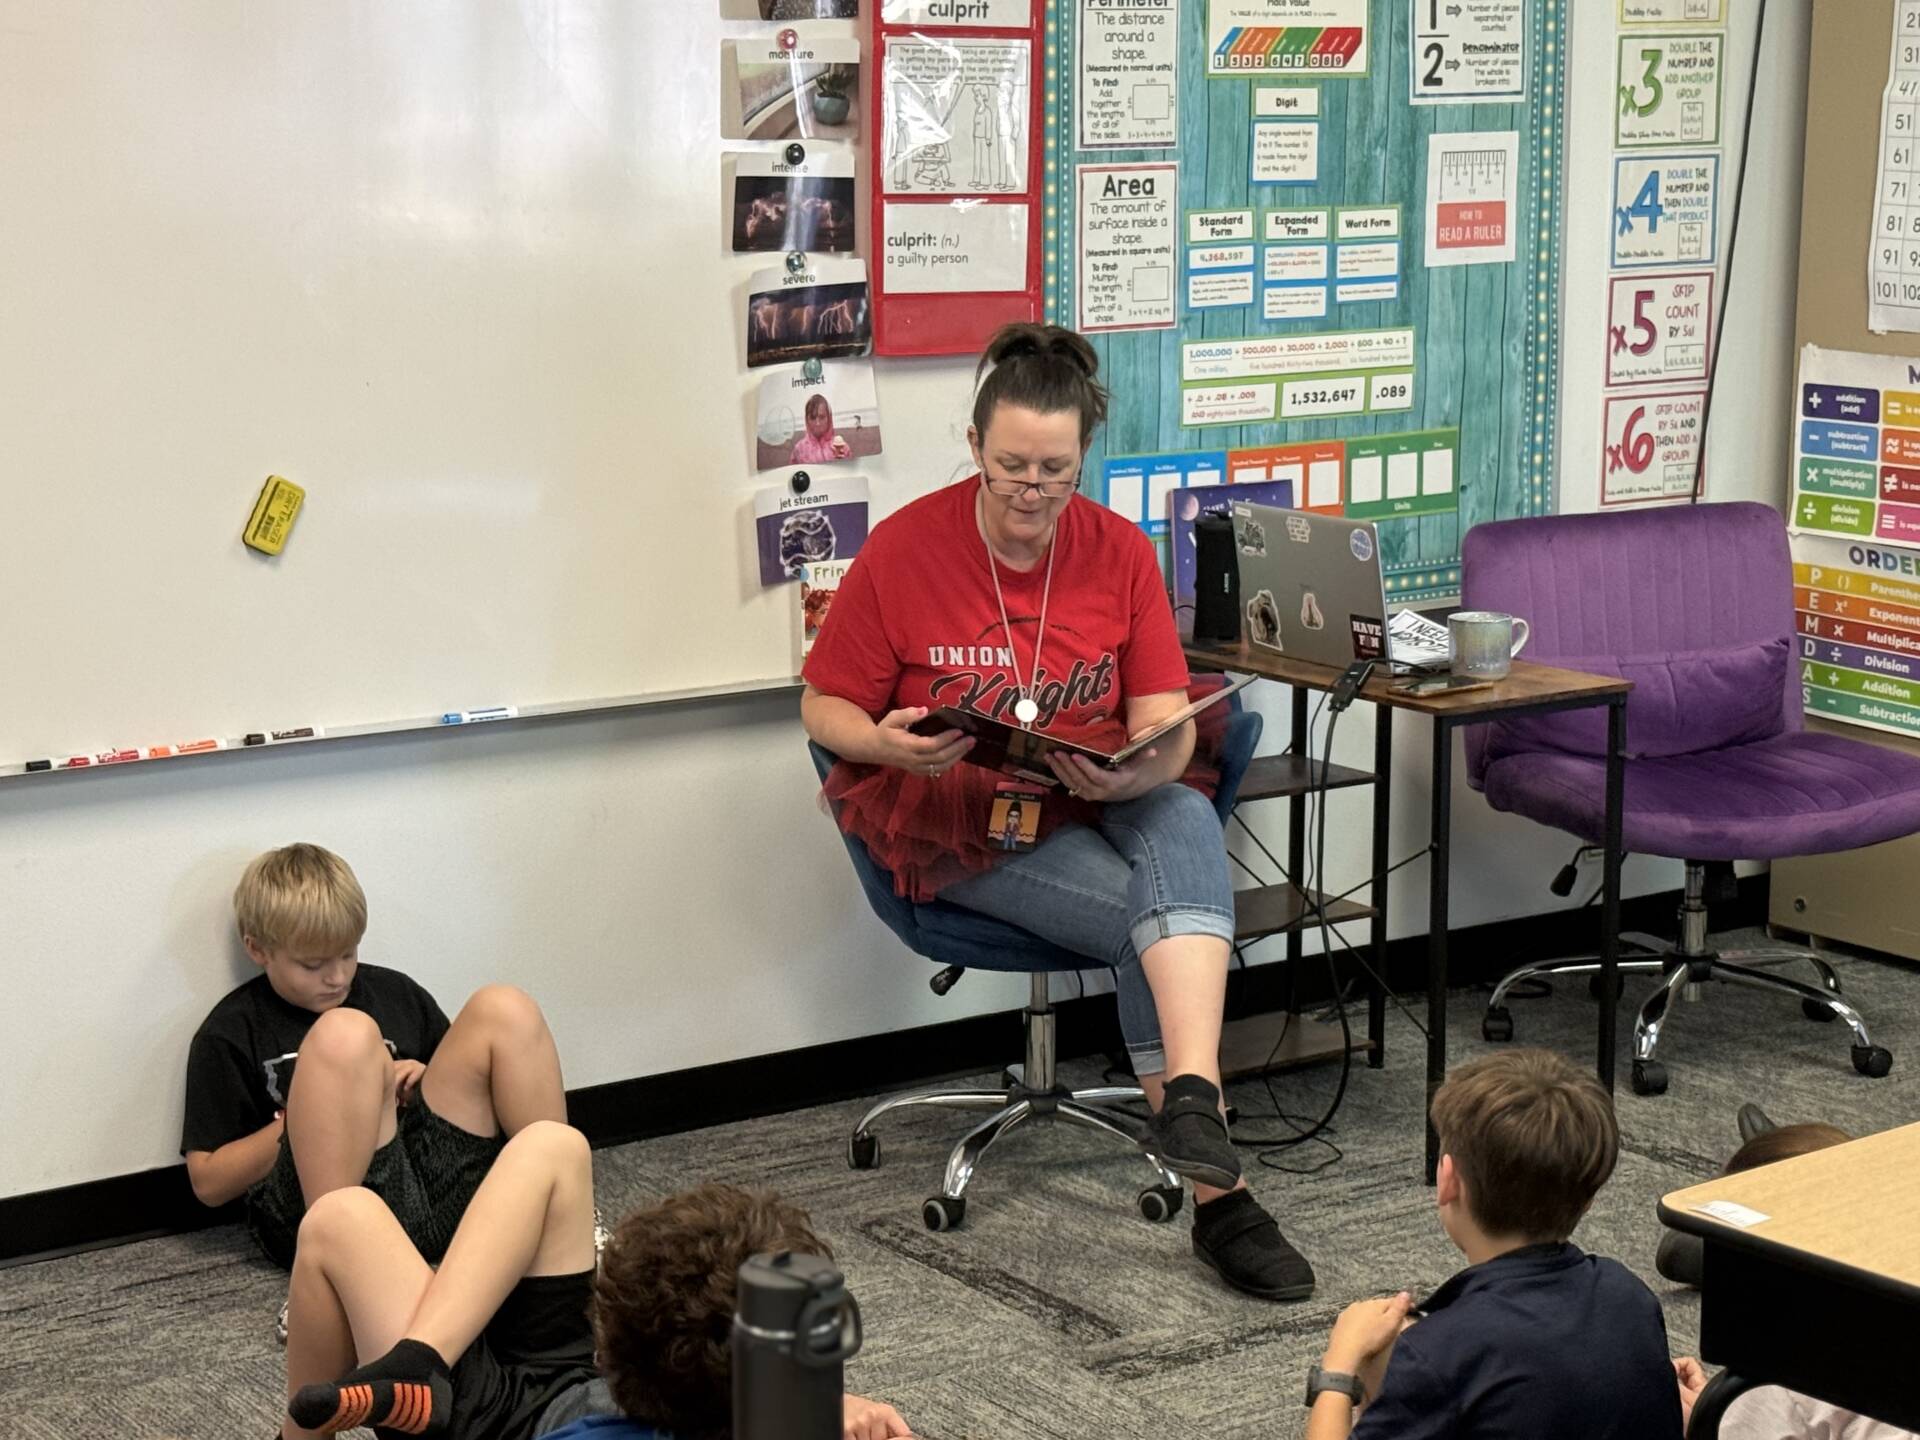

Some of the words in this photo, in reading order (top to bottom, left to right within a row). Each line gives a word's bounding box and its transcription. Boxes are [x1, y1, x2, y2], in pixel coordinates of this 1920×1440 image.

[928, 1, 989, 22] culprit
[1095, 12, 1115, 26] The
[1118, 11, 1165, 25] distance
[1906, 13, 1920, 29] 21
[1104, 30, 1144, 43] around
[1147, 32, 1155, 43] a
[1462, 42, 1520, 53] Denominator
[1699, 41, 1712, 53] THE
[1112, 48, 1147, 63] shape.
[1904, 47, 1919, 63] 31
[1086, 64, 1122, 73] (Measured
[1130, 63, 1154, 72] normal
[1423, 42, 1444, 87] 2
[1667, 58, 1697, 69] NUMBER
[1699, 57, 1715, 68] AND
[1676, 88, 1701, 99] GROUP
[1899, 81, 1917, 96] 41
[1275, 97, 1298, 109] Digit
[1894, 114, 1911, 130] 51
[1893, 148, 1909, 165] 61
[771, 161, 809, 174] intense
[1695, 167, 1708, 178] THE
[1102, 174, 1155, 198] Area
[1665, 183, 1694, 193] NUMBER
[1695, 182, 1710, 192] AND
[1890, 181, 1906, 198] 71
[1090, 202, 1109, 215] The
[1111, 202, 1151, 213] amount
[1153, 200, 1167, 212] of
[1664, 197, 1681, 208] THEN
[1682, 196, 1708, 208] DOUBLE
[1199, 215, 1244, 227] Standard
[1275, 215, 1319, 228] Expanded
[1459, 210, 1473, 220] HOW
[1475, 210, 1482, 220] TO
[1088, 217, 1129, 231] surface
[1131, 216, 1158, 229] inside
[1160, 217, 1168, 228] a
[1345, 219, 1368, 228] Word
[1370, 218, 1391, 227] Form
[1886, 215, 1902, 232] 81
[1210, 227, 1233, 237] Form
[1287, 226, 1309, 235] Form
[1440, 226, 1463, 241] READ
[1464, 226, 1471, 240] A
[1473, 225, 1502, 240] RULER
[887, 233, 937, 251] culprit:
[940, 233, 960, 249] (n.)
[887, 255, 894, 264] a
[897, 250, 928, 268] guilty
[931, 254, 969, 267] person
[1883, 249, 1899, 265] 91
[783, 273, 816, 285] severe
[1672, 284, 1695, 298] SKIP
[1876, 281, 1897, 299] 101
[1665, 302, 1700, 319] COUNT
[1669, 326, 1680, 338] BY
[790, 375, 826, 389] impact
[1291, 389, 1356, 405] 1,532,647
[1376, 385, 1406, 399] .089
[1835, 393, 1866, 405] addition
[1674, 401, 1701, 413] COUNT
[1840, 403, 1861, 415] (add)
[1680, 418, 1696, 429] AND
[1655, 435, 1674, 448] THEN
[1676, 435, 1690, 445] ADD
[1692, 435, 1698, 443] A
[1827, 430, 1870, 442] subtraction
[1831, 440, 1867, 453] (subtract)
[1822, 467, 1873, 480] multiplication
[1829, 478, 1865, 490] (multiply)
[779, 497, 792, 511] jet
[793, 493, 829, 507] stream
[1831, 504, 1861, 515] division
[1831, 513, 1859, 526] (divide)
[1811, 567, 1822, 584] P
[1809, 592, 1820, 610] E
[1352, 621, 1382, 636] HAVE
[1805, 616, 1819, 634] M
[928, 645, 1013, 667] UNION
[1804, 640, 1816, 657] D
[1864, 656, 1910, 674] Division
[1802, 664, 1814, 682] A
[1862, 679, 1911, 699] Addition
[929, 653, 1115, 731] Knights
[1802, 687, 1811, 705] S
